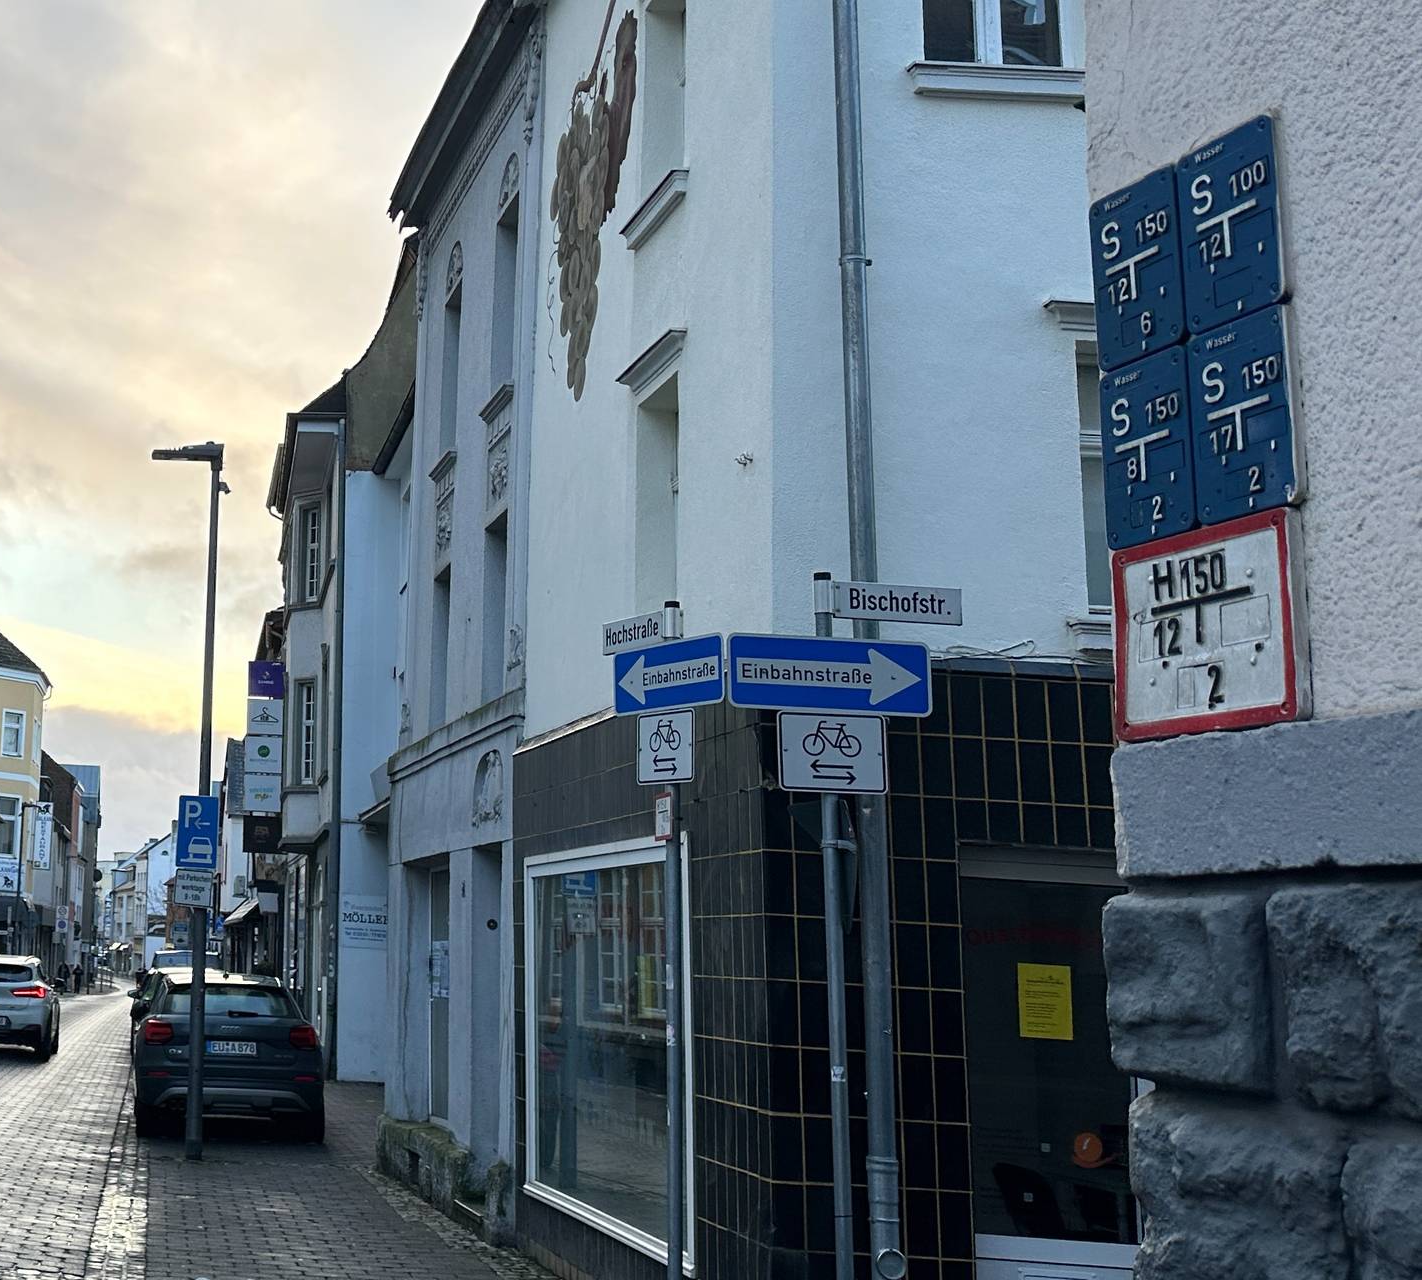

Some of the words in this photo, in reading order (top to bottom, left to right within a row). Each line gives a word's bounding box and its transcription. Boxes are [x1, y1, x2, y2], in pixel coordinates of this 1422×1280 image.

[1195, 143, 1225, 163] Wasser
[1191, 174, 1212, 215] S
[1229, 160, 1266, 197] 100
[1103, 192, 1131, 211] Wasser
[1101, 221, 1120, 260] S
[1135, 210, 1167, 243] 150
[1200, 233, 1222, 263] 12
[1108, 278, 1129, 305] 12
[1140, 312, 1152, 334] 6
[1205, 332, 1237, 350] Wasser
[1113, 370, 1143, 387] Wasser
[1202, 361, 1225, 404] S
[1241, 356, 1278, 391] 150
[1110, 398, 1130, 437] S
[1145, 394, 1178, 426] 150
[1210, 424, 1233, 454] 17
[1127, 457, 1138, 479] 8
[1249, 466, 1261, 491] 2
[1152, 495, 1163, 521] 2
[849, 588, 951, 616] Bischofstr.
[605, 617, 659, 647] Hochstraße
[1153, 618, 1183, 657] 12
[642, 662, 716, 687] Einbahnstraße
[742, 663, 872, 685] Einbahnstraße
[1207, 664, 1226, 704] 2
[184, 800, 202, 829] P
